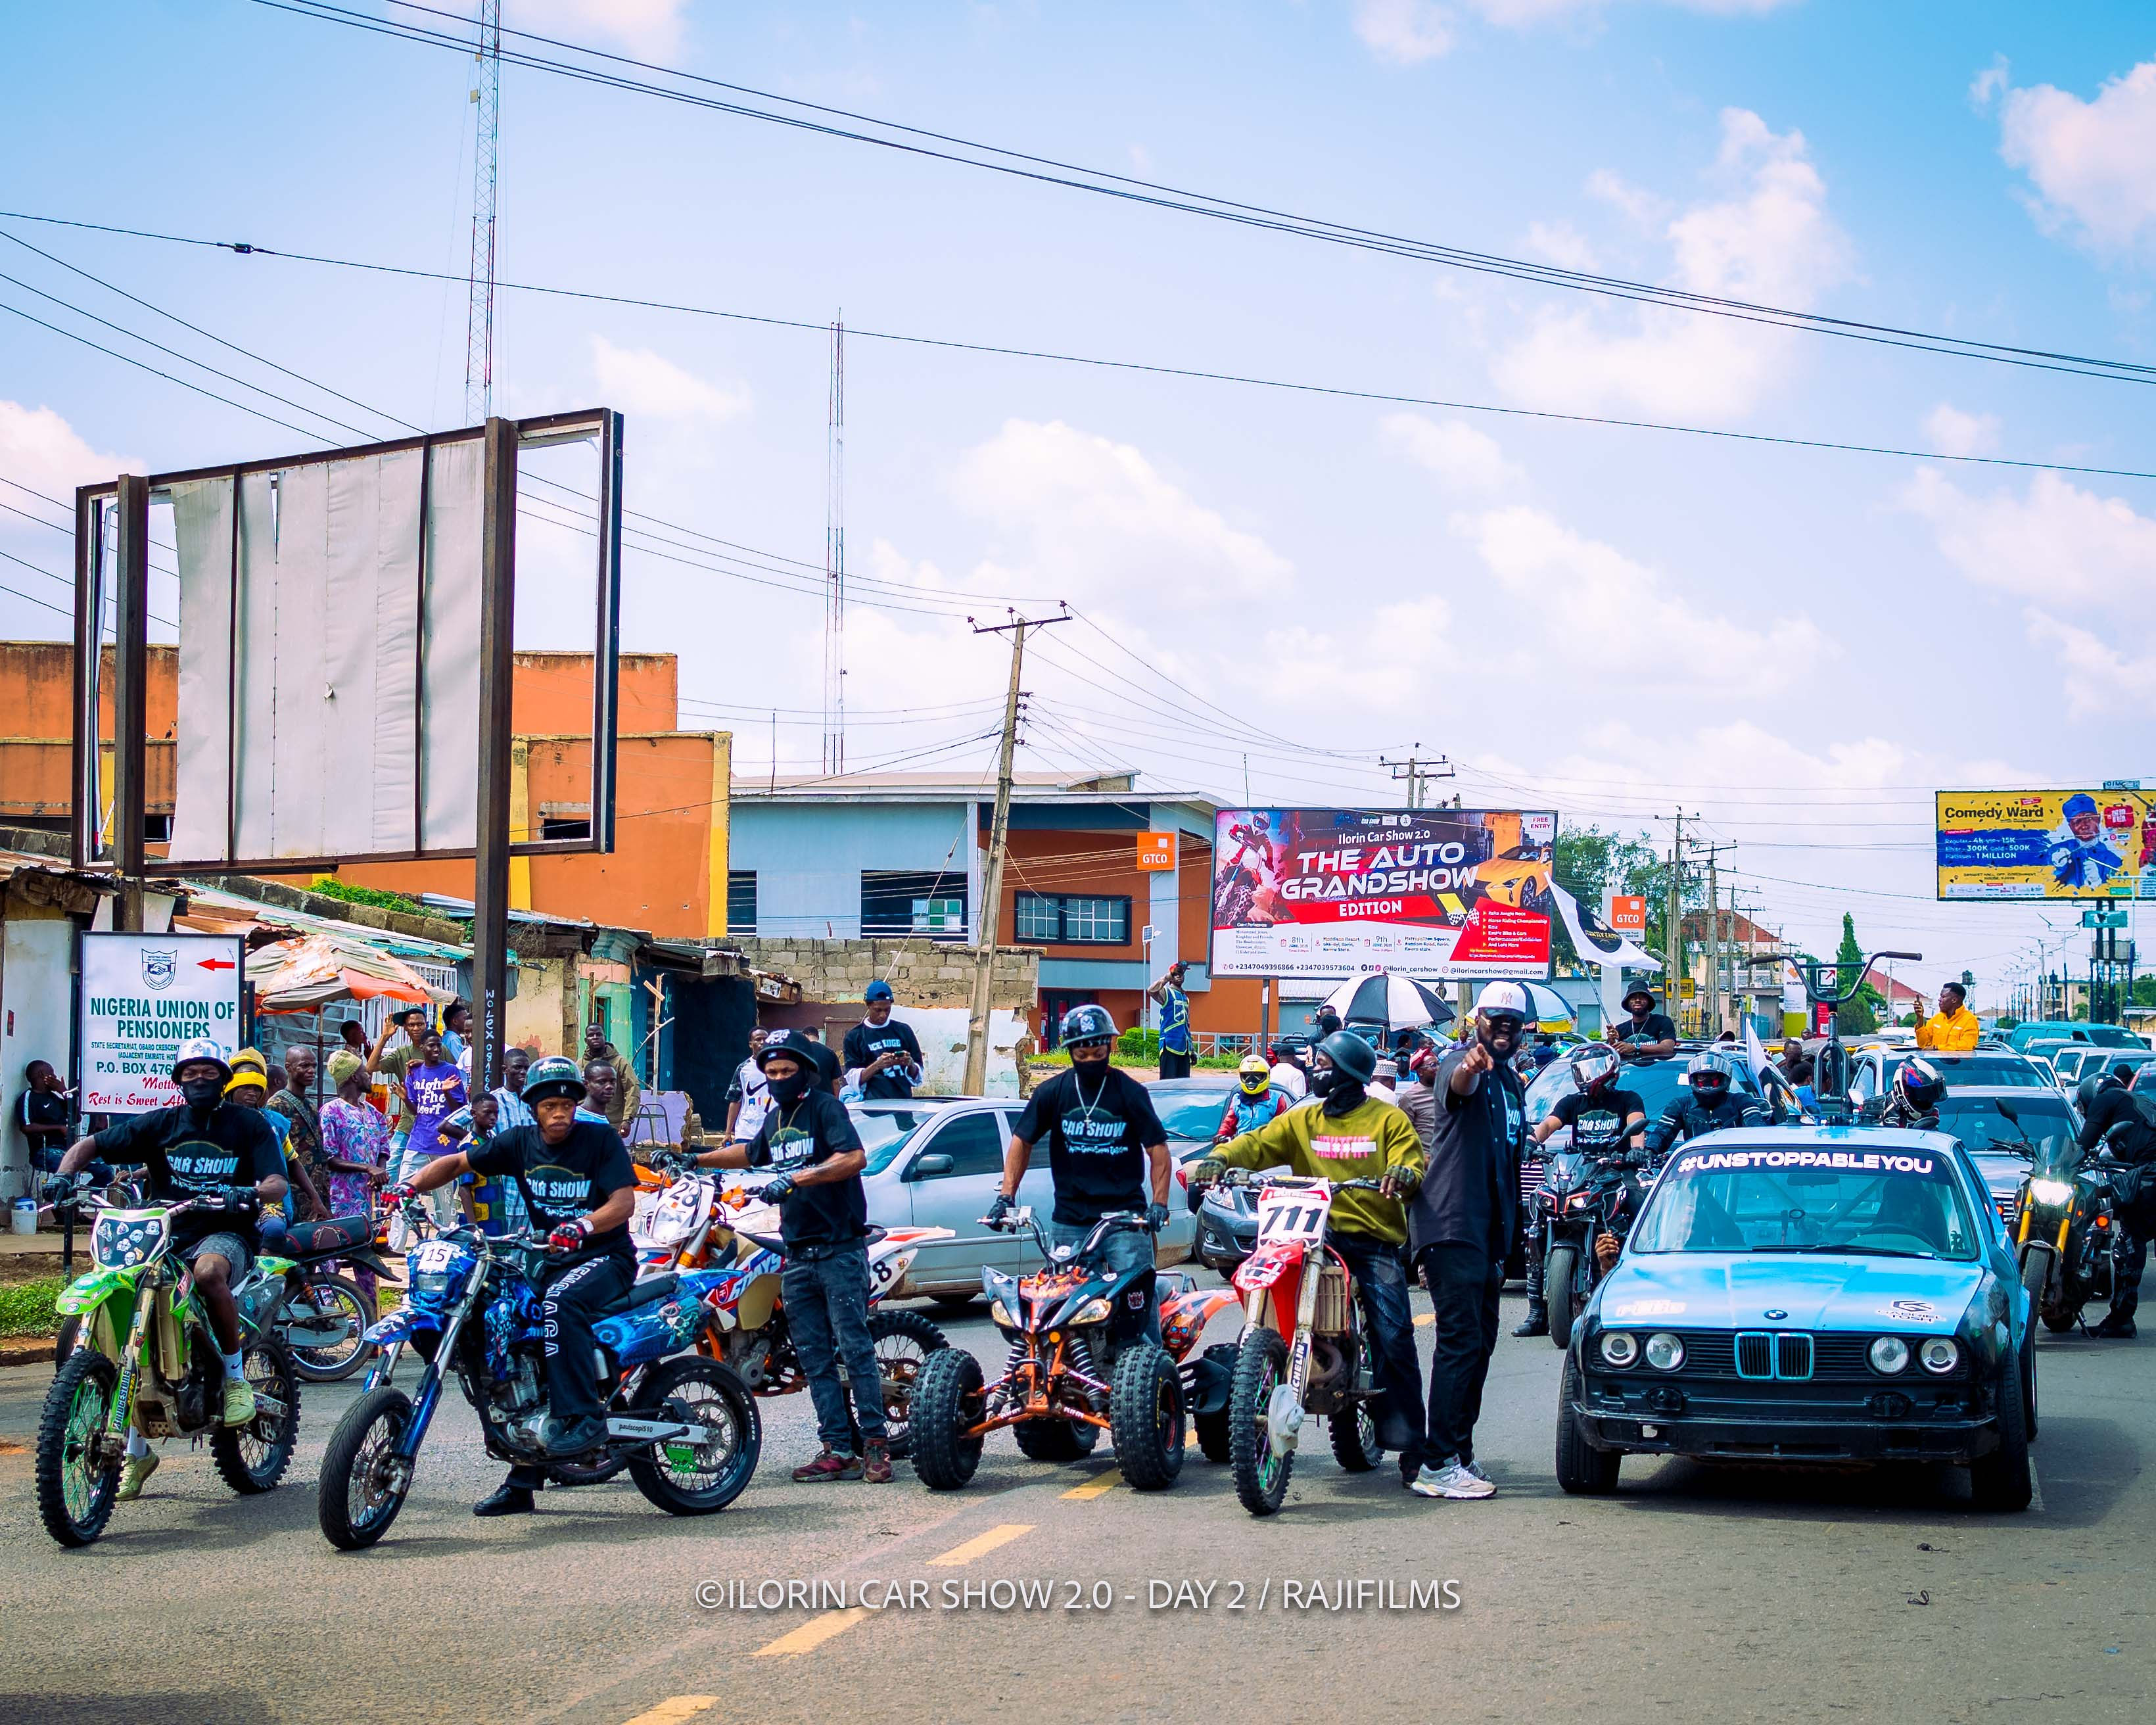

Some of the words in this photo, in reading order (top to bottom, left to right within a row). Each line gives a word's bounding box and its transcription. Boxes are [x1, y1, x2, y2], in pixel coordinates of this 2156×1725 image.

[1945, 807, 2002, 819] Comedy
[2006, 807, 2044, 817] Ward
[1338, 832, 1366, 844] Ilorin
[1367, 832, 1385, 842] Car
[1386, 830, 1414, 841] Show
[1415, 830, 1430, 839] 2.0
[1142, 854, 1167, 864] GTCO
[1296, 849, 1361, 874] THE
[1369, 842, 1465, 868] AUTO
[1281, 866, 1479, 900] GRANDSHOW
[1339, 900, 1402, 917] EDITION
[1616, 914, 1639, 923] GTCO
[91, 997, 152, 1018] NIGERIA
[156, 999, 210, 1020] UNION
[214, 1001, 235, 1020] OF
[118, 1020, 210, 1039] PENSIONERS
[97, 1062, 119, 1073] P.O.
[122, 1062, 147, 1075] BOX
[89, 1092, 111, 1106] Rest
[115, 1093, 122, 1105] is
[126, 1093, 158, 1106] Sweet
[1062, 1120, 1085, 1135] CAR
[1087, 1122, 1127, 1137] SHOW
[785, 1137, 814, 1158] SHOW
[194, 1157, 239, 1174] SHOW
[1677, 1152, 1933, 1173] #UNSTOPPABLEYOU
[550, 1180, 592, 1198] SHOW
[1261, 1206, 1323, 1236] 711
[426, 1248, 448, 1262] 15
